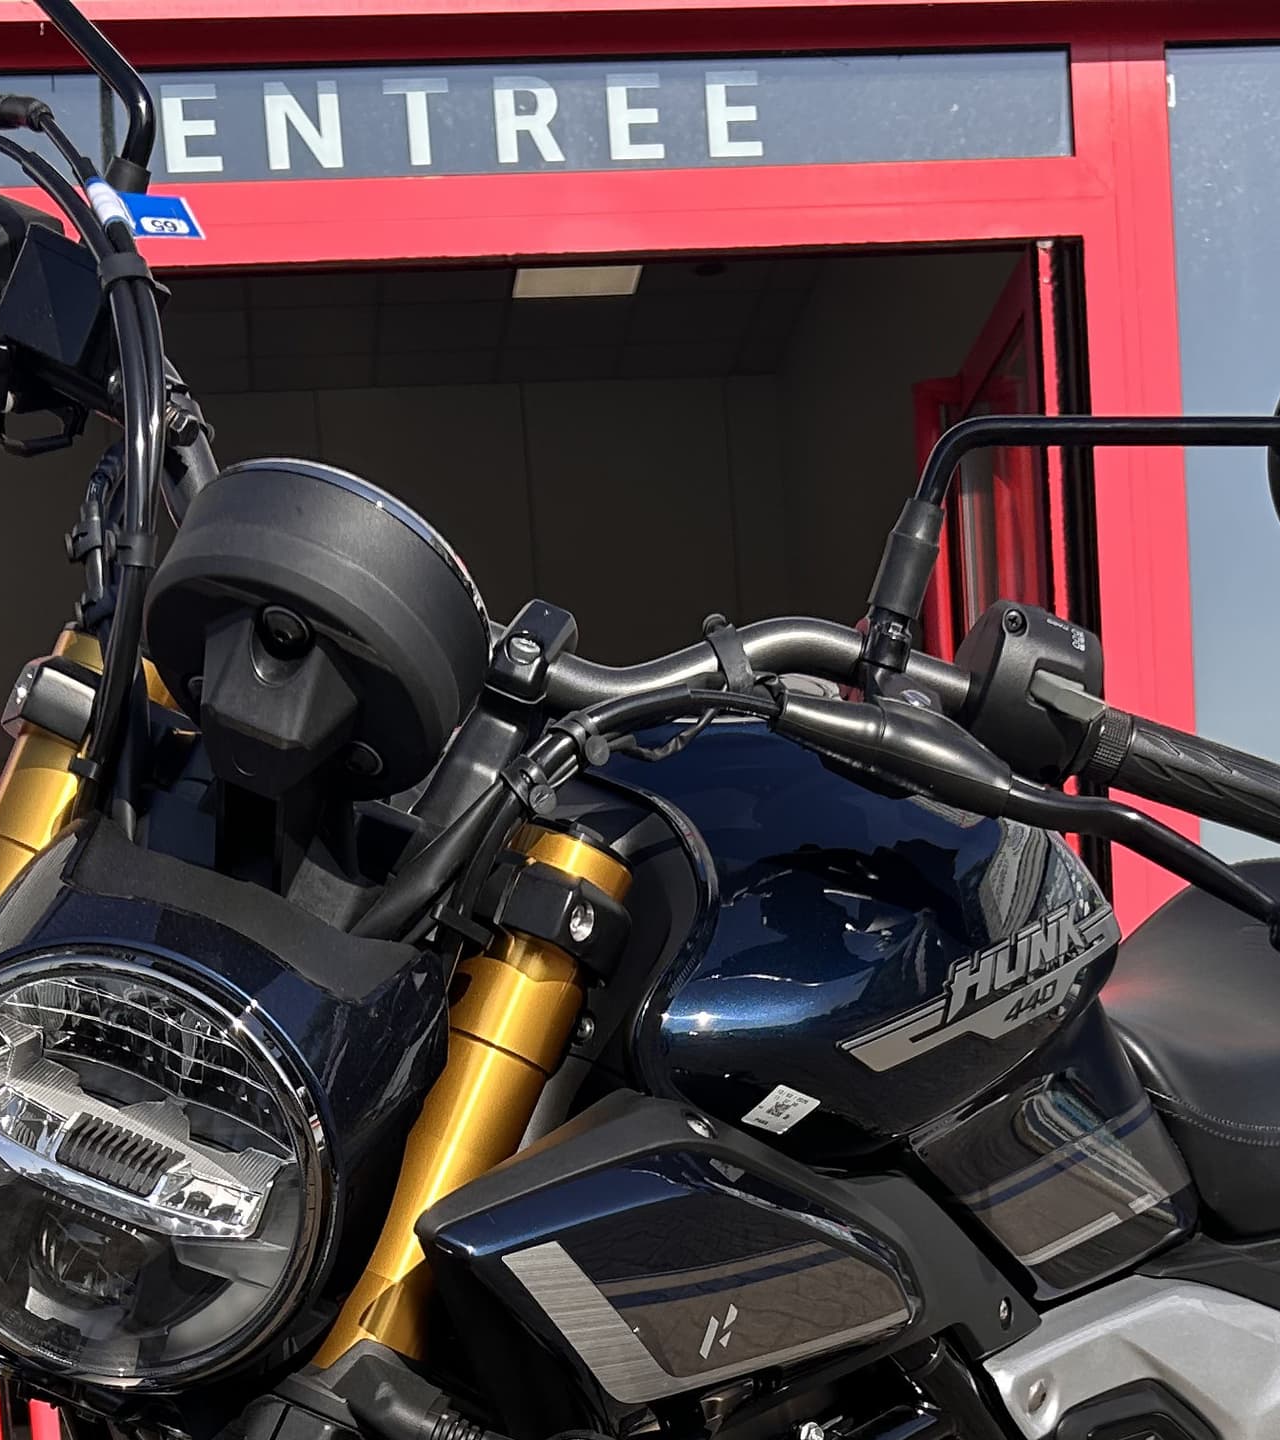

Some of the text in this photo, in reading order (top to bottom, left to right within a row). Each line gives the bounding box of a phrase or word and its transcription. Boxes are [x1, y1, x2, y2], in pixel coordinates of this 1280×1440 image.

[160, 70, 765, 173] ENTREE
[947, 900, 1090, 1023] HUNK
[1004, 979, 1059, 1022] 440
